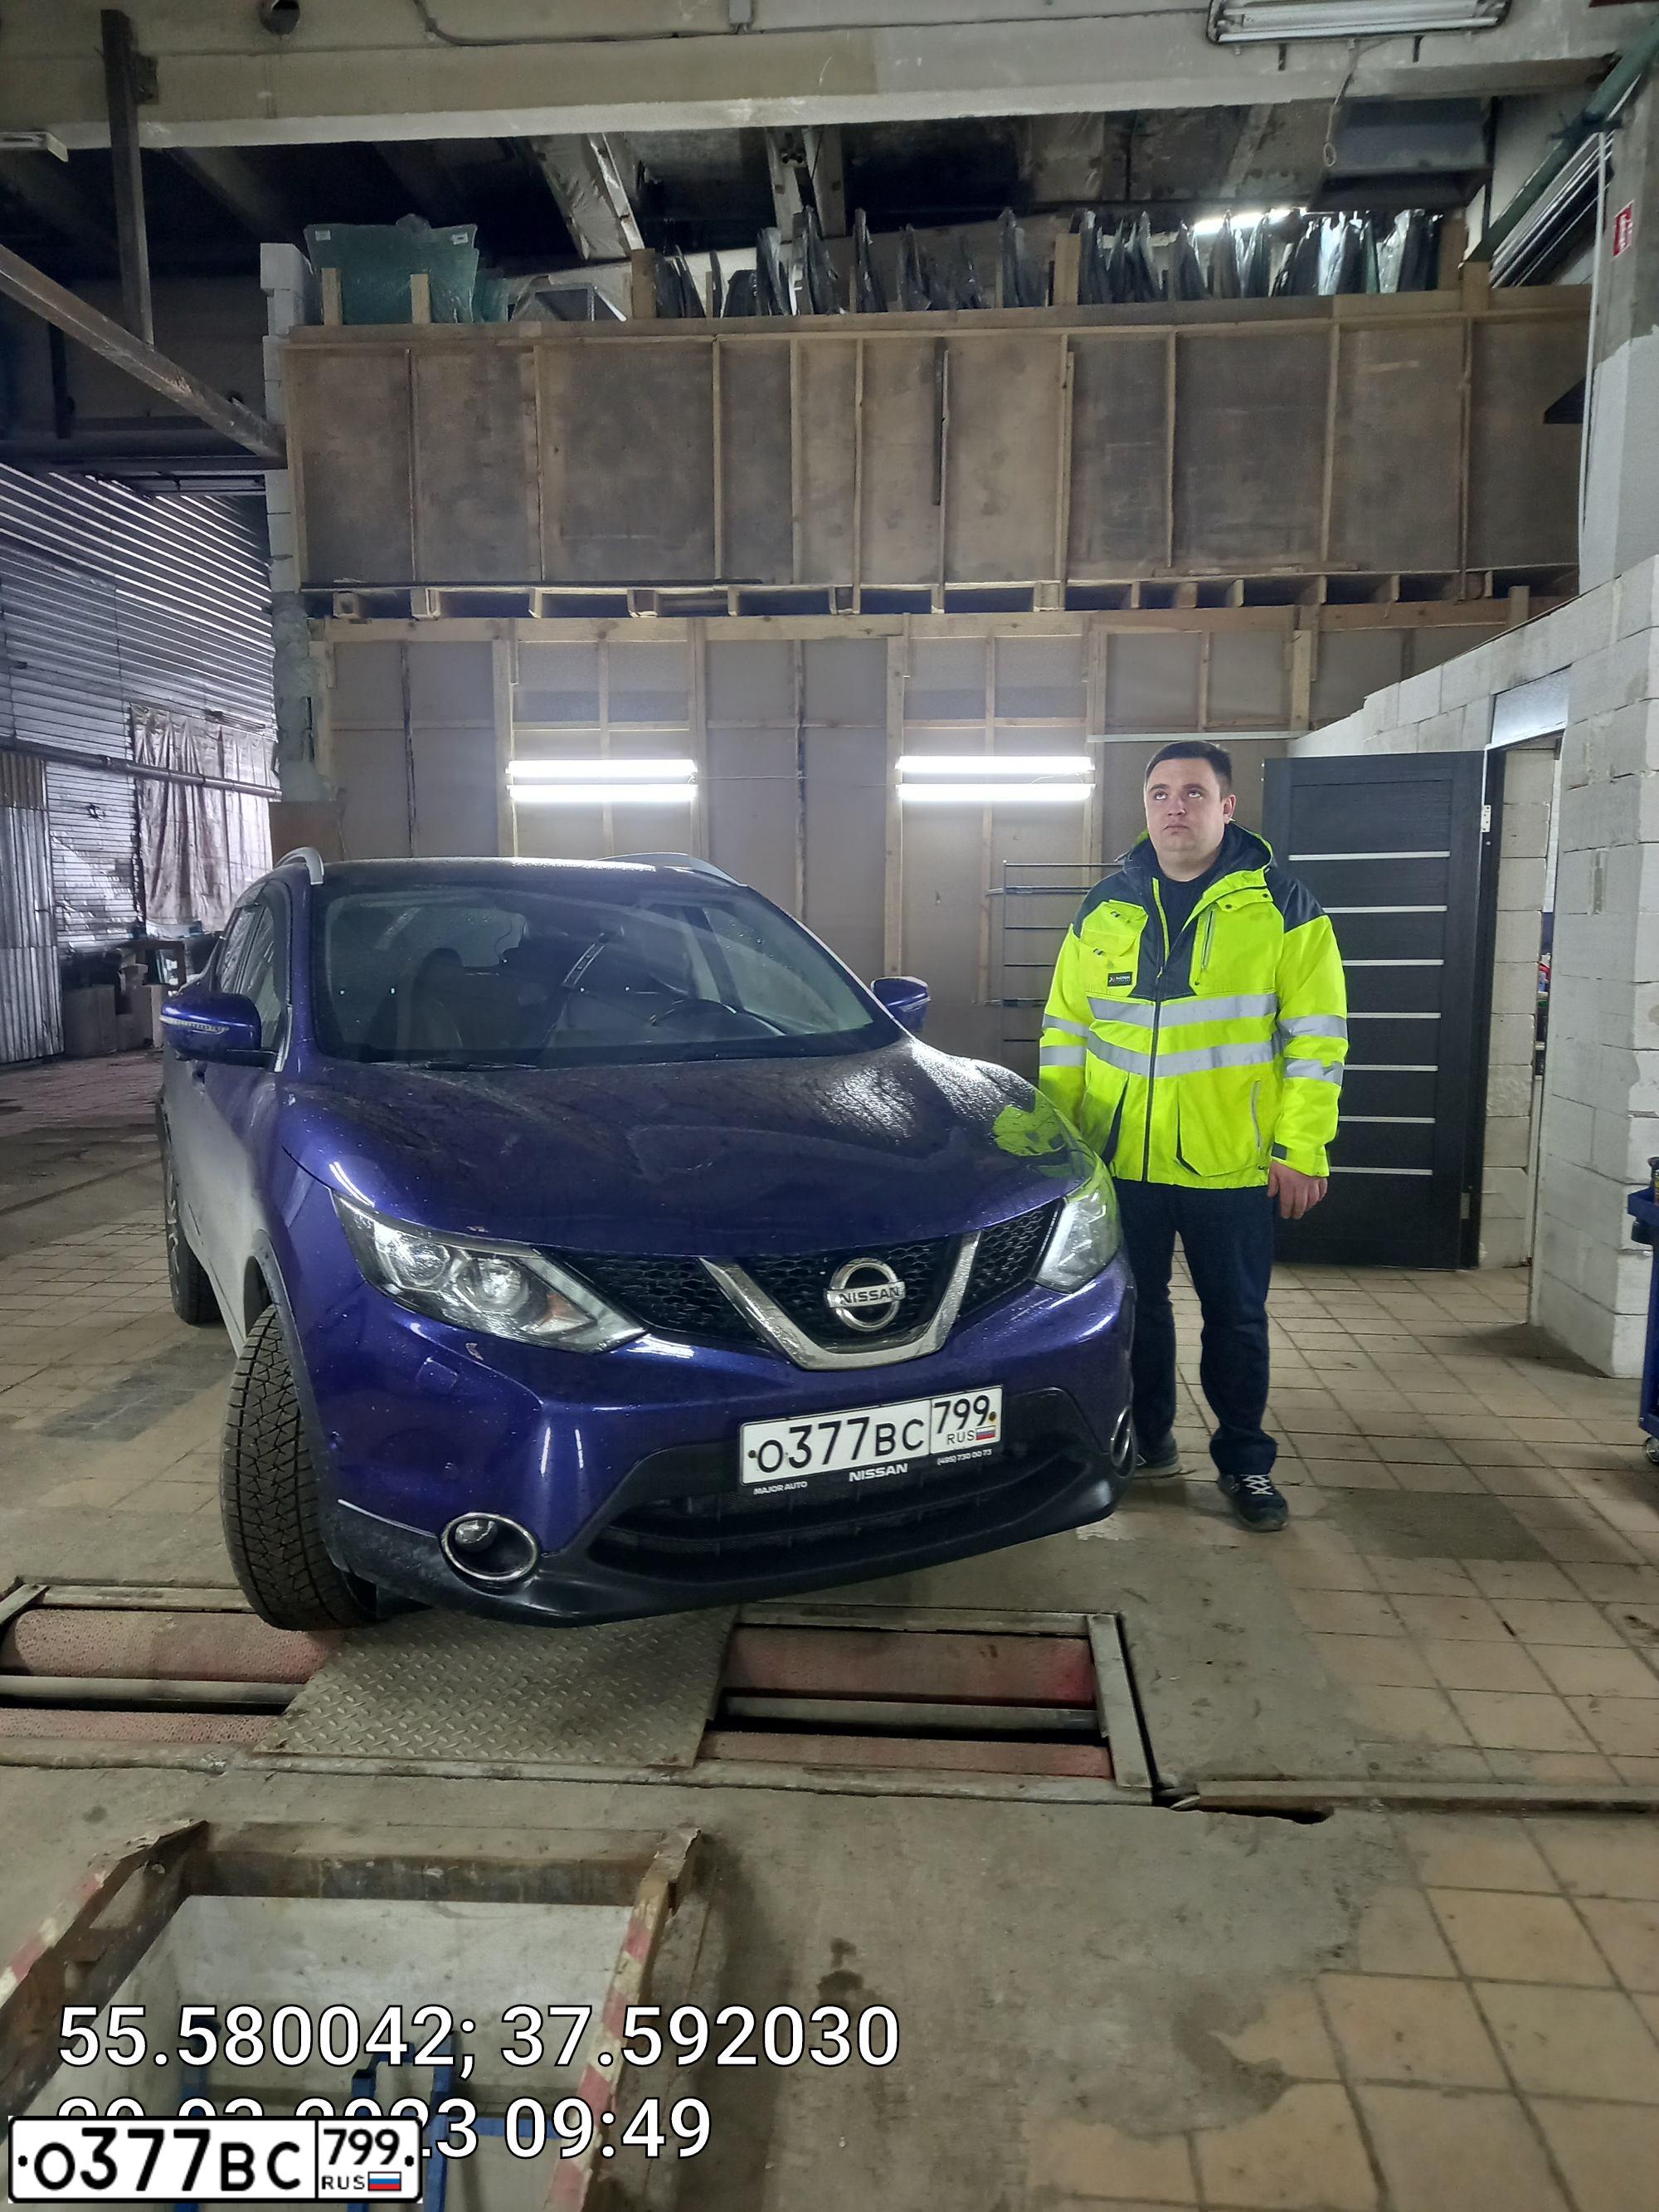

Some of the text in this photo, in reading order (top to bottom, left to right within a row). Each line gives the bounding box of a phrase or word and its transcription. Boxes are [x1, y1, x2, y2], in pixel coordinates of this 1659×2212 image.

[839, 1287, 901, 1305] NISSAN
[934, 1395, 990, 1435] 799
[947, 1430, 975, 1445] RUS
[849, 1463, 908, 1482] NISSAN
[753, 1481, 808, 1494] MAJOR AUTO
